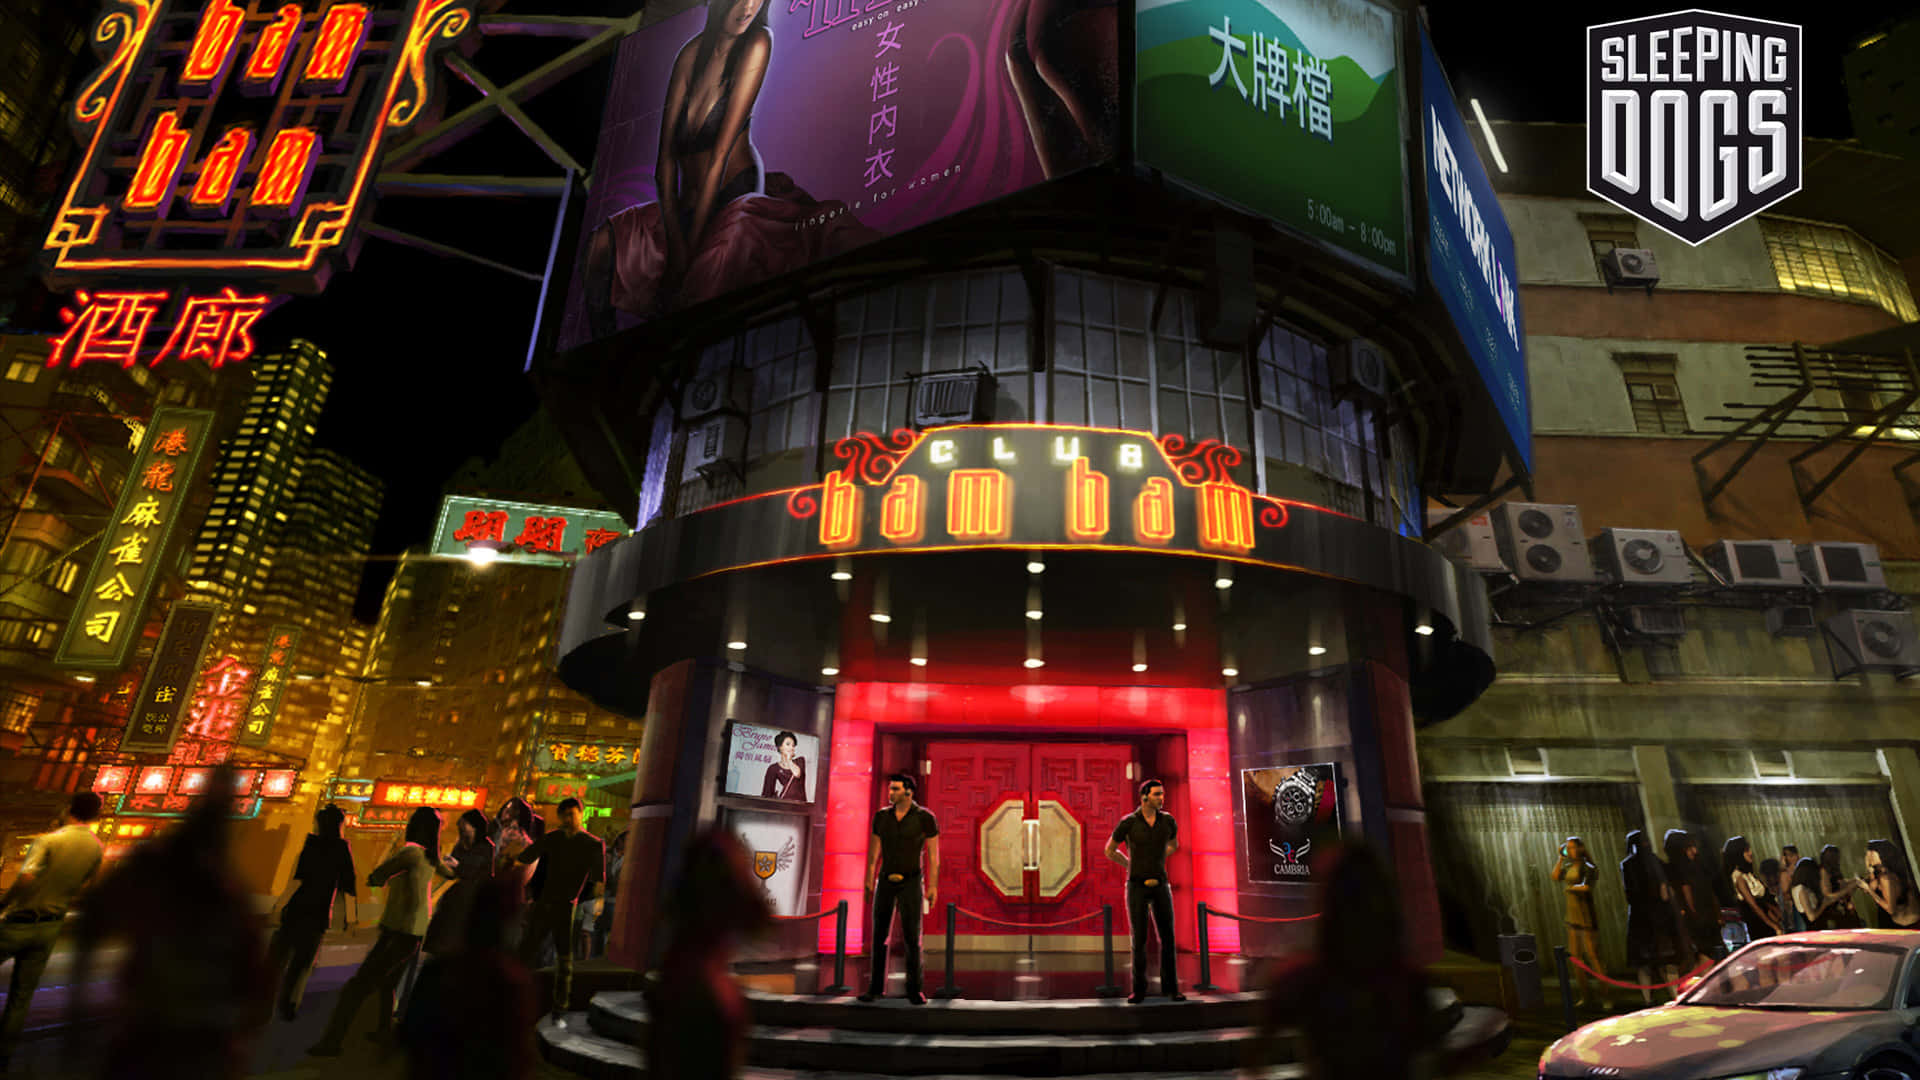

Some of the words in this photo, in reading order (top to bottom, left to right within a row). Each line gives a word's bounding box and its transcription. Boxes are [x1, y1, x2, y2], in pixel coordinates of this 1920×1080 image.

[1208, 15, 1333, 141] 大牌檔
[794, 201, 861, 231] lingerie
[873, 188, 897, 202] for
[908, 164, 962, 190] women
[1307, 198, 1345, 233] 5:00am
[1360, 221, 1397, 257] 8:00pm
[1430, 103, 1495, 297] NETWORK
[46, 287, 271, 369] 酒廊
[929, 435, 1143, 468] CLUB
[1274, 864, 1310, 875] CAMBRIA
